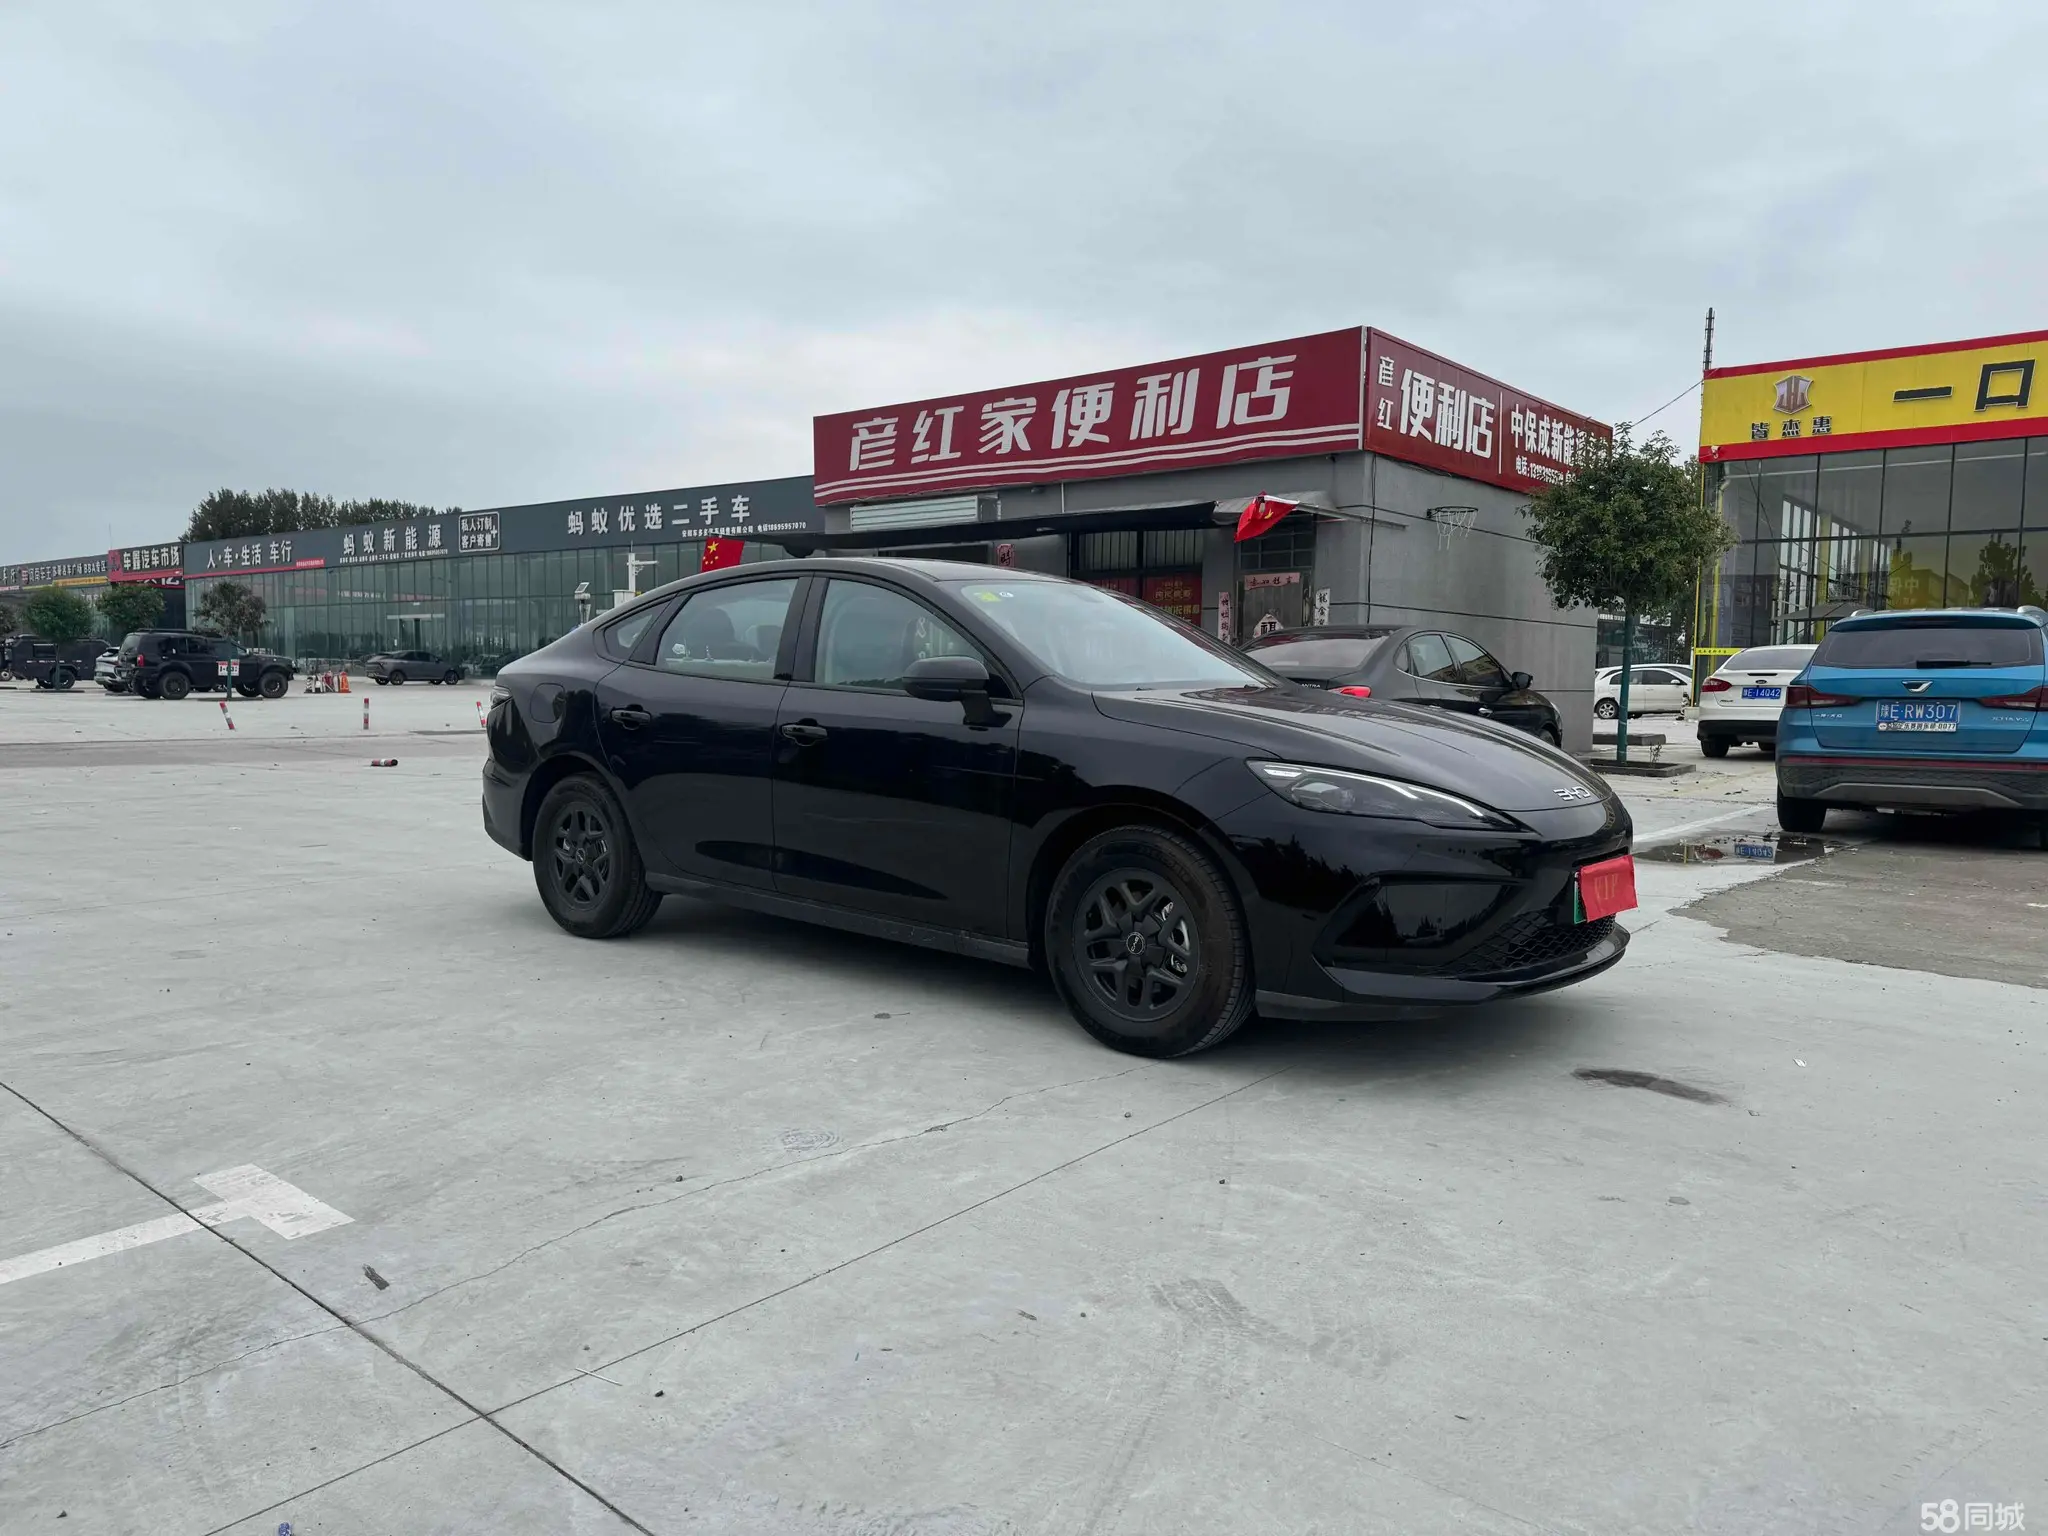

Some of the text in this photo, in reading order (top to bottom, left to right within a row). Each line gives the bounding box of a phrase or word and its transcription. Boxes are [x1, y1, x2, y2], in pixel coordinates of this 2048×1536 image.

[1893, 359, 2036, 412] 一口
[848, 354, 1297, 471] 彦红家便利店
[1399, 368, 1495, 459] 便利店
[461, 516, 492, 532] 私人订制
[568, 494, 750, 535] 蚂蚁优选二手车
[269, 540, 292, 564] 车行
[343, 524, 442, 556] 蚂蚁新能源
[1880, 703, 1956, 720] 豫E·RW307
